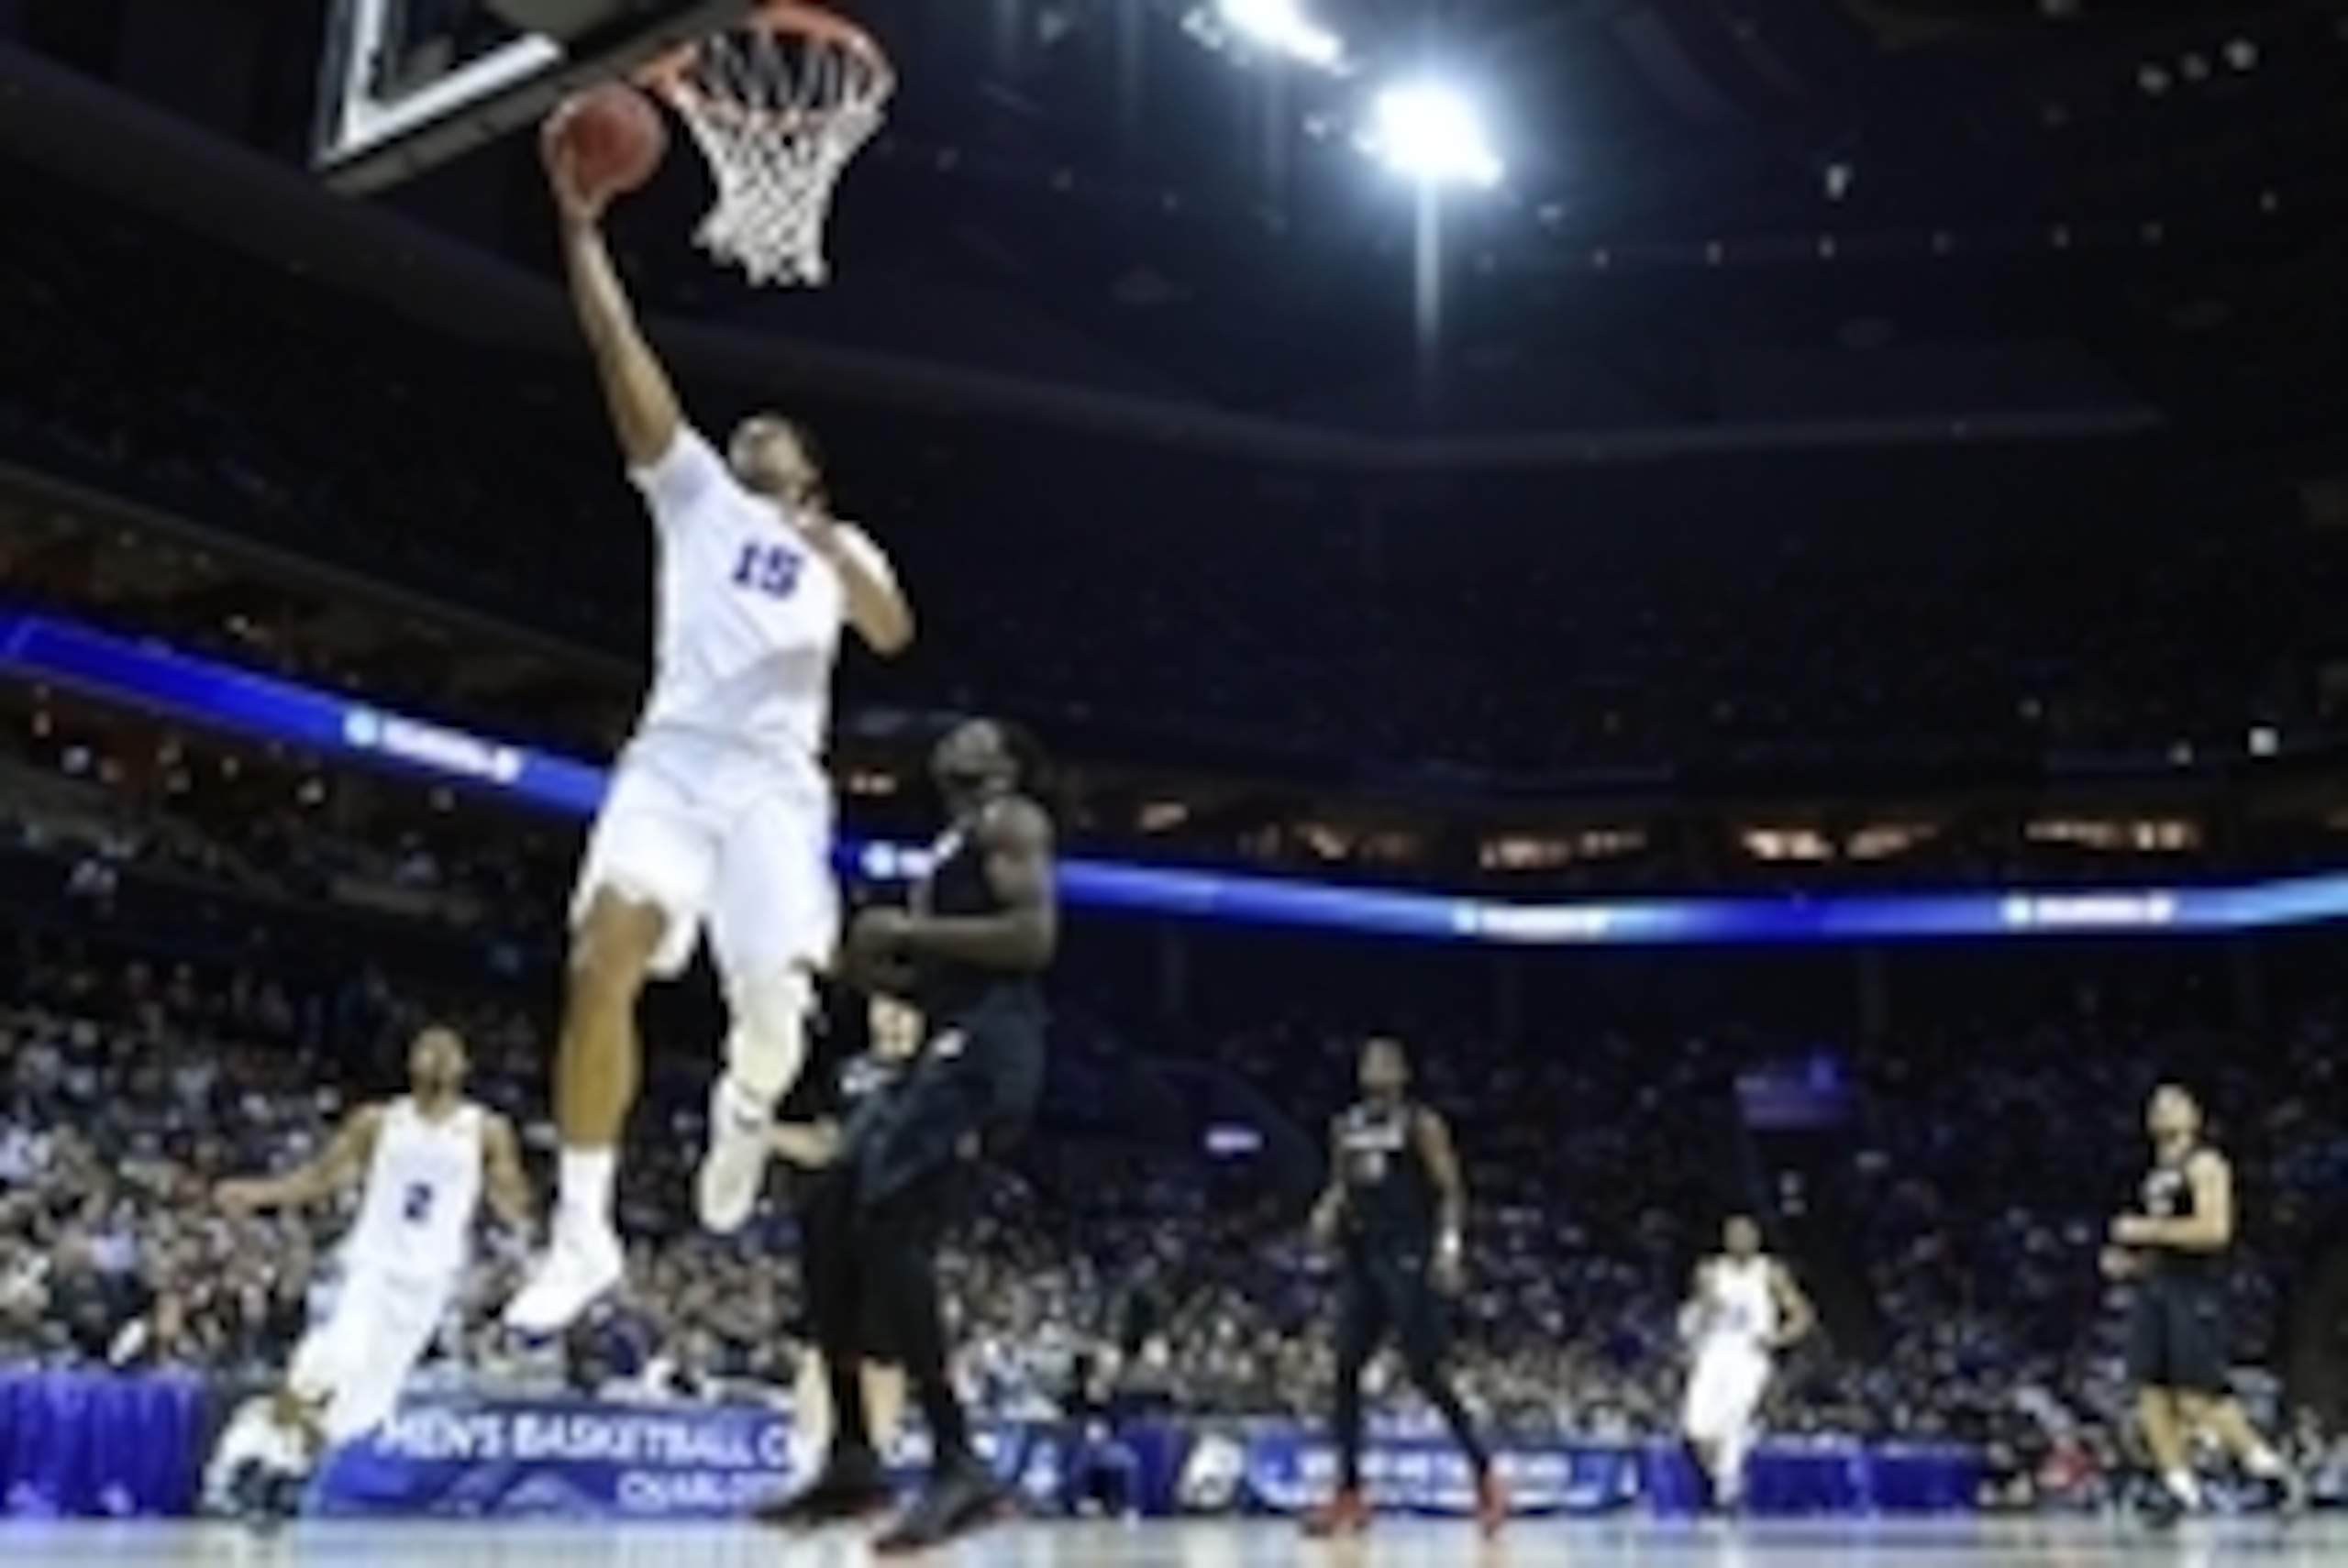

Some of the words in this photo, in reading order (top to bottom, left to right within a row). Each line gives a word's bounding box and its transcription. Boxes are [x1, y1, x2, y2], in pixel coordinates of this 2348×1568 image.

[733, 539, 803, 599] 15
[404, 1181, 434, 1224] 2
[513, 1415, 755, 1466] BASKETBALL
